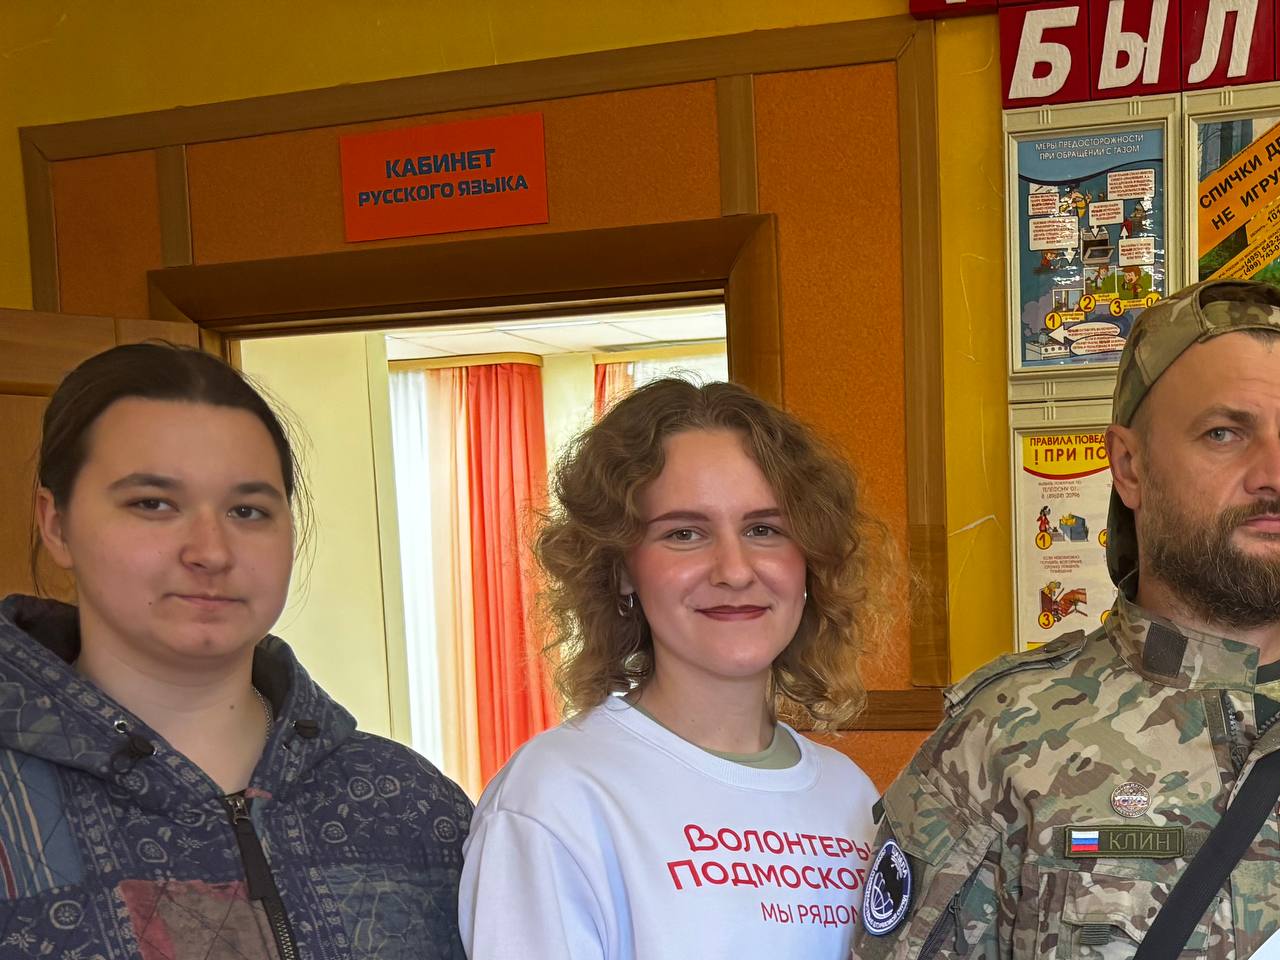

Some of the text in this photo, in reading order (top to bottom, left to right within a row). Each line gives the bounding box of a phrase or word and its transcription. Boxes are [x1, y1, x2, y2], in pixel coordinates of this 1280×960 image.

[1035, 134, 1144, 150] МЕРЫ ПРЕДОСТОРОЖНОСТИ
[1040, 145, 1140, 160] ПРИ ОБРАЩЕНИИ С ГАЗОМ
[386, 149, 496, 178] КАБИНЕТ
[358, 175, 529, 206] РУССКОГО ЯЗЫКА
[1199, 154, 1263, 209] СПИЧКИ
[1212, 206, 1236, 230] НЕ
[1243, 259, 1261, 275] (499)
[1244, 250, 1261, 267] (495)
[1048, 314, 1055, 328] 1
[1083, 296, 1091, 310] 2
[1114, 300, 1122, 315] 3
[1030, 434, 1105, 447] ПРАВИЛА ПОВЕД
[1045, 448, 1077, 462] ПРИ
[1039, 534, 1046, 548] 1
[1043, 613, 1050, 627] 3
[1108, 832, 1171, 852] КЛИН
[666, 859, 866, 890] ПОДМОСКО
[760, 902, 794, 924] МЫ
